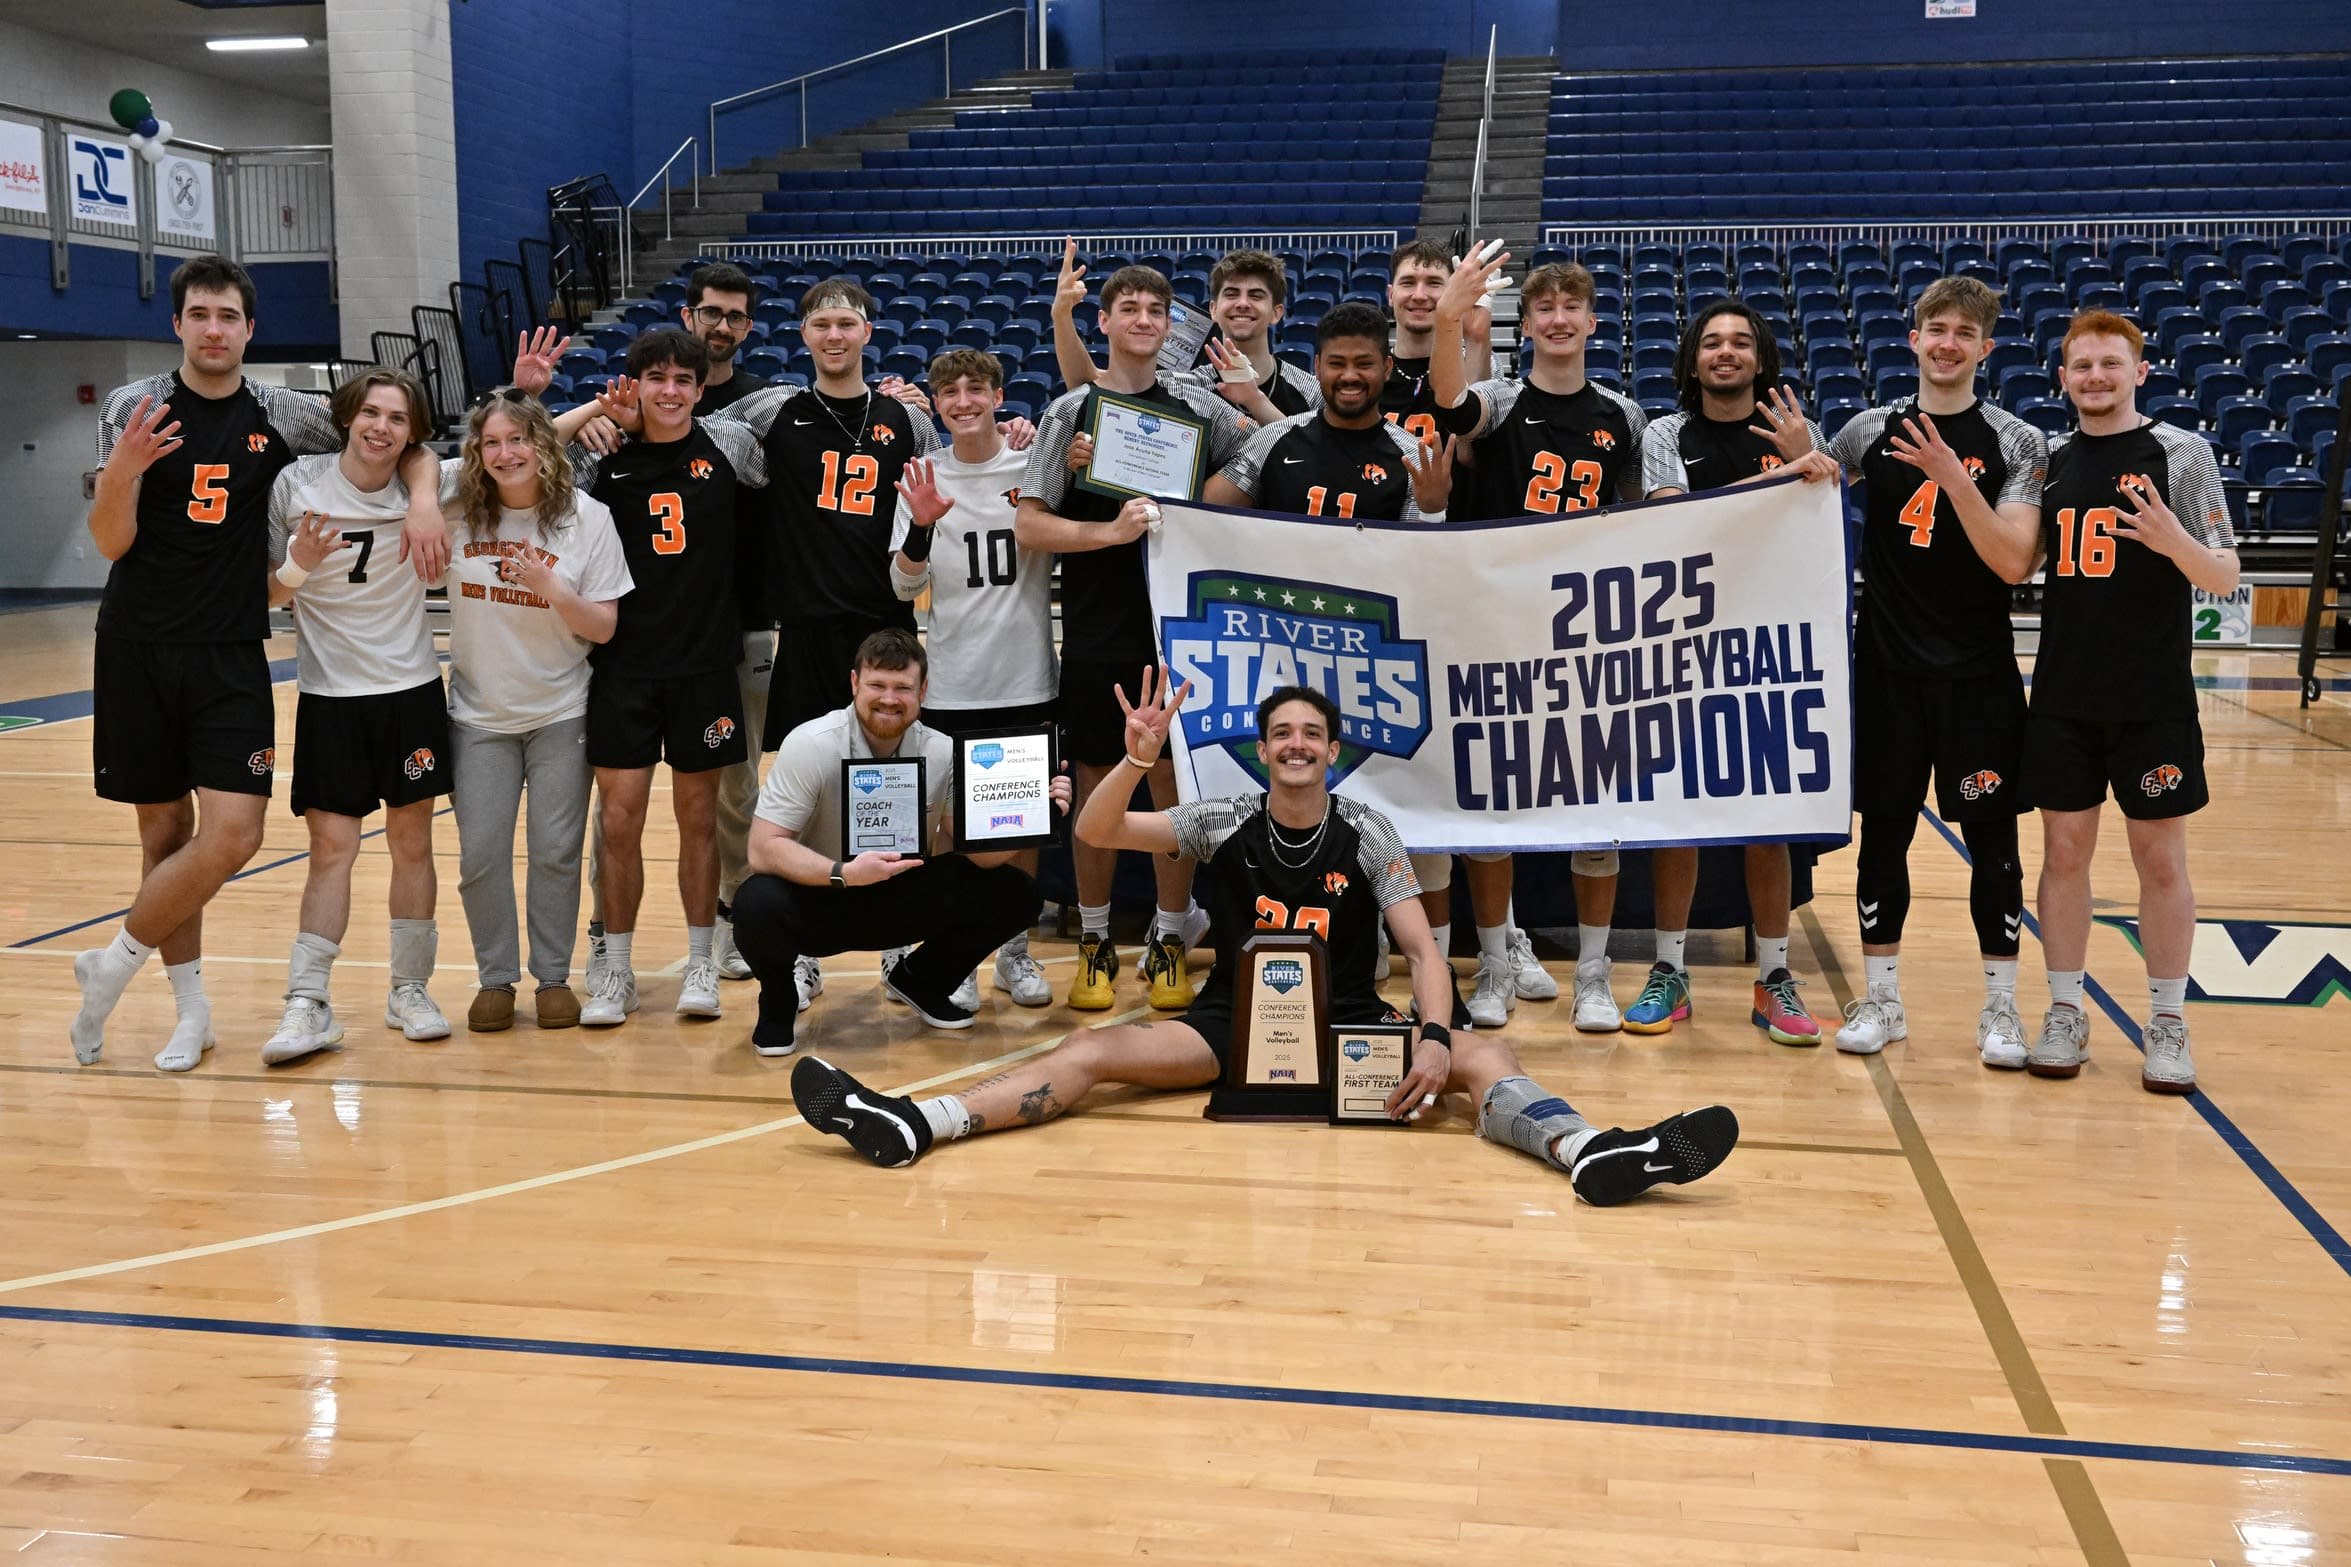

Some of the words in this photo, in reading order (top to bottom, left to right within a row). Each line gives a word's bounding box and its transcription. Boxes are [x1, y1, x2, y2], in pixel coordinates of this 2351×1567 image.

[187, 463, 230, 524] 5
[817, 450, 879, 516] 12
[1524, 450, 1603, 514] 23
[1307, 485, 1357, 519] 11
[1899, 480, 1939, 548] 4
[648, 492, 687, 555] 3
[2056, 507, 2117, 577] 16
[341, 530, 374, 584] 7
[963, 528, 1017, 588] 10
[1551, 552, 1716, 651] 2025
[1222, 609, 1369, 653] RIVER
[2195, 608, 2221, 640] 2
[1170, 639, 1421, 729] STATES
[1447, 657, 1569, 717] MEN'S
[1577, 622, 1824, 708] VOLLEYBALL
[1201, 712, 1392, 743] CONNCE
[1452, 688, 1831, 811] CHAMPIONS
[854, 776, 882, 786] STATES
[973, 780, 1041, 792] CONFERENCE
[973, 789, 1041, 802] CHAMPIONS
[856, 801, 893, 811] COACH
[856, 816, 889, 828] YEAR
[991, 815, 1023, 828] NAIA
[1264, 970, 1302, 981] STATES
[1266, 1037, 1300, 1045] Volleyball
[1269, 1069, 1297, 1080] NAIA
[1344, 1080, 1371, 1088] FIRST
[1373, 1080, 1400, 1089] TEAM
